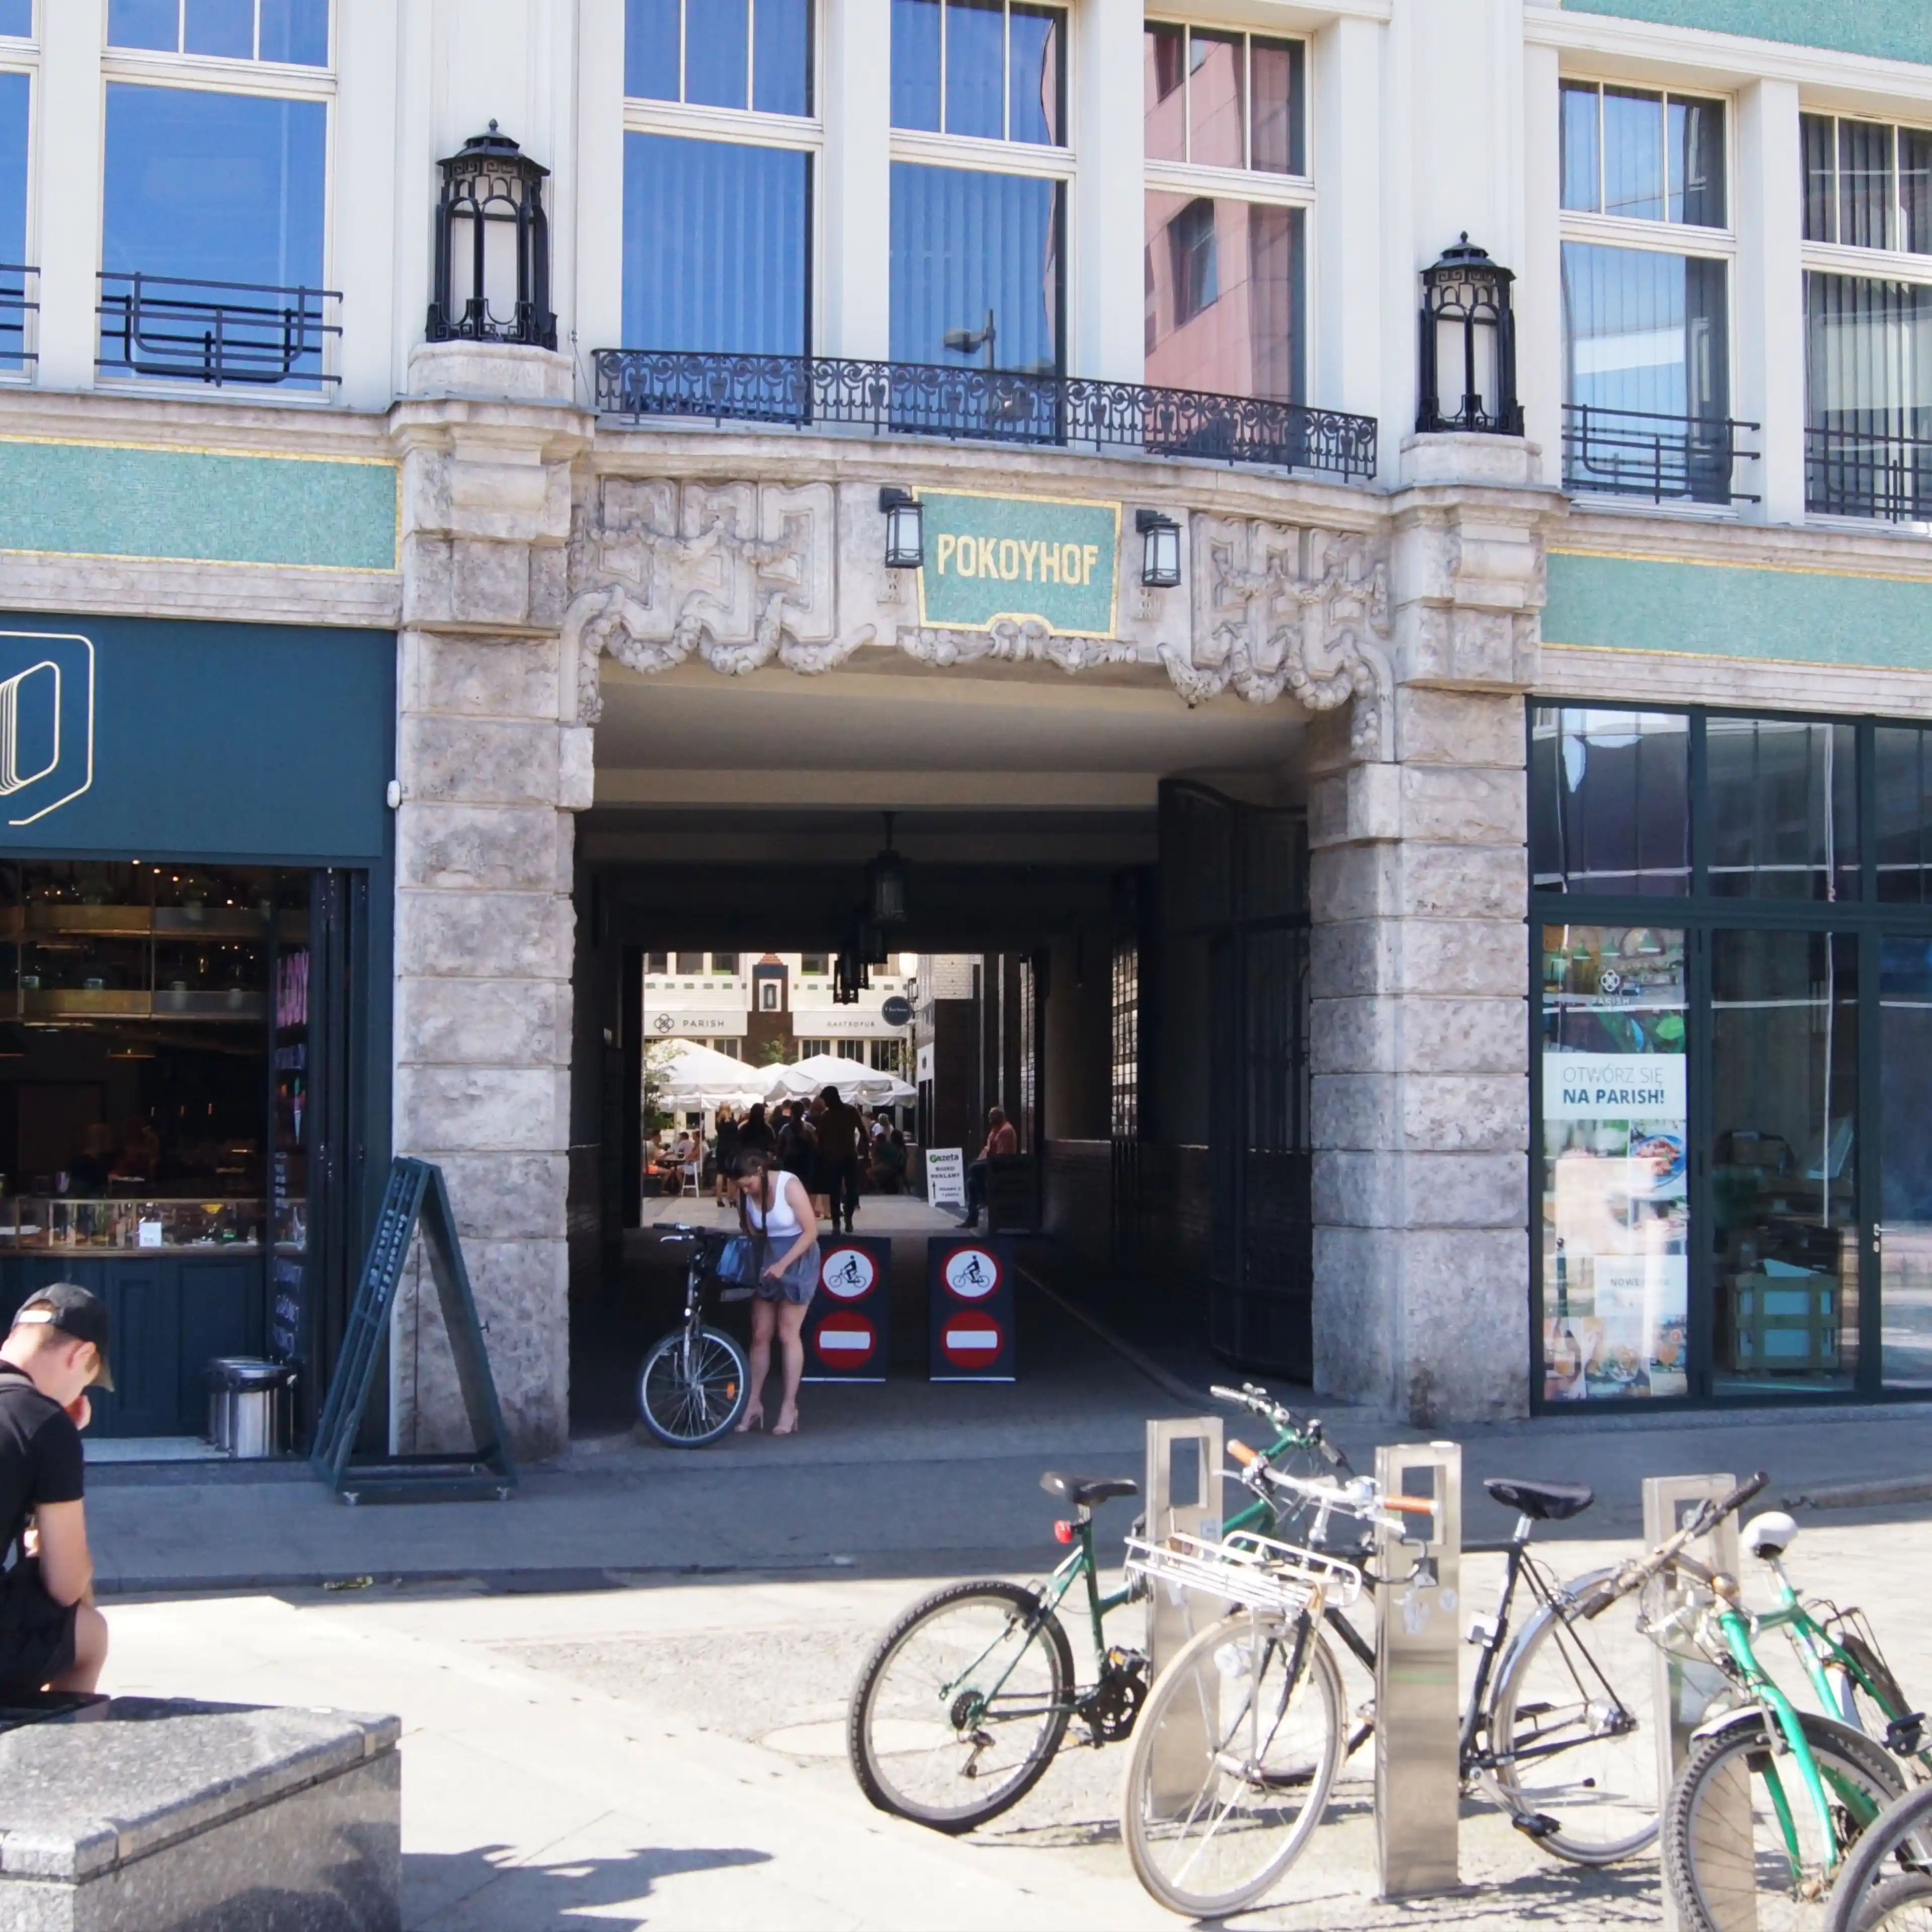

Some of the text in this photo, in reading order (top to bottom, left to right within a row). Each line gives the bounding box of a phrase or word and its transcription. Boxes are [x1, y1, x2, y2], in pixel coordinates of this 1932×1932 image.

[937, 533, 1099, 585] POKOYHOF
[1591, 997, 1630, 1006] PARISH
[683, 1019, 725, 1027] PARISH
[1563, 1063, 1664, 1087] OTWÓRZ SIĘ
[1563, 1088, 1665, 1104] NA PARISH!
[929, 1153, 959, 1163] Gazeta
[1609, 1277, 1640, 1286] NOWE
